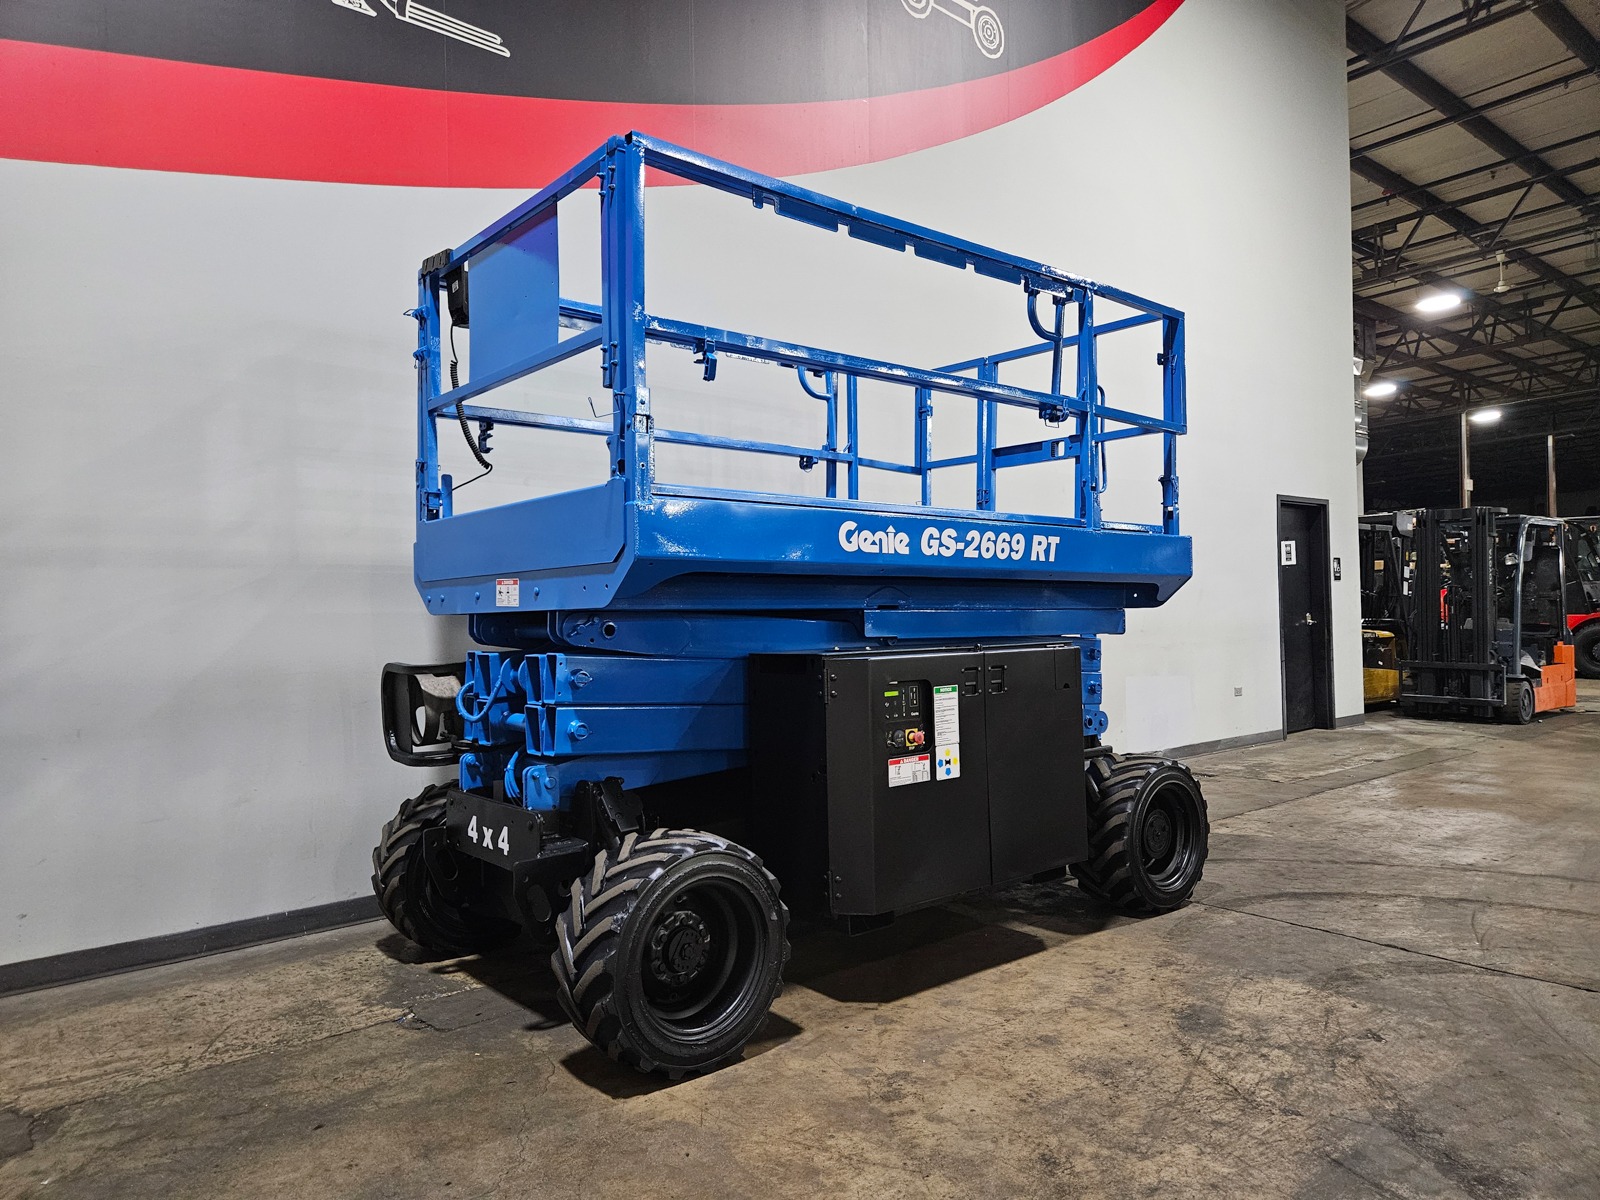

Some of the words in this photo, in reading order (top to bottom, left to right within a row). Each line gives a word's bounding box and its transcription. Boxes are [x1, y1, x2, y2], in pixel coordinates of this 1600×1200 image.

[838, 520, 910, 555] Genie
[920, 527, 1026, 561] GS-2669
[1030, 534, 1061, 562] RT
